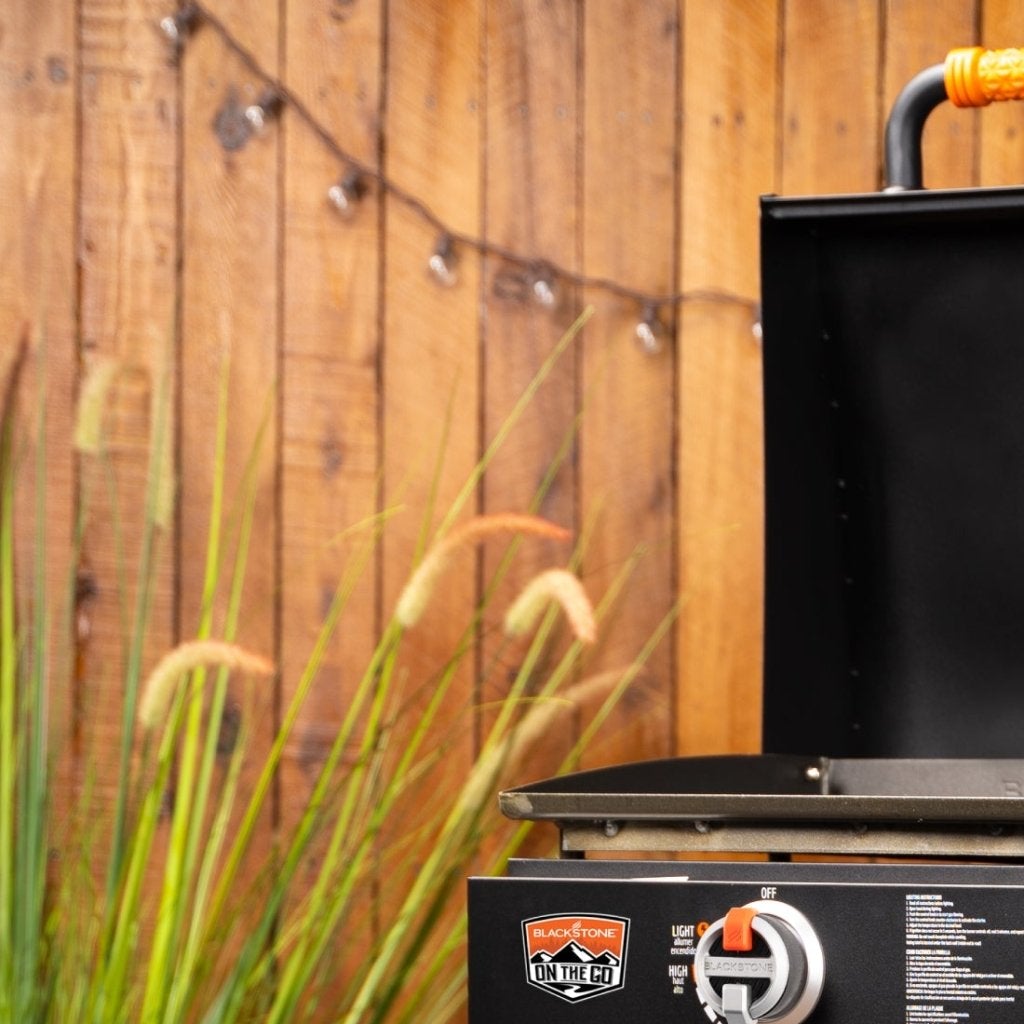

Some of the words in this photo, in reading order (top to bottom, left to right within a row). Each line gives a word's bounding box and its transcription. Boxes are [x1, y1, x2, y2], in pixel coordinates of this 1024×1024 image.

[761, 887, 777, 899] OFF
[534, 928, 616, 938] BLACKSTONE
[671, 925, 695, 938] LIGHT
[668, 965, 688, 977] HIGH
[704, 961, 773, 972] BLACKSTONE
[535, 964, 558, 981] ON
[561, 966, 587, 981] THE
[590, 966, 614, 985] GO
